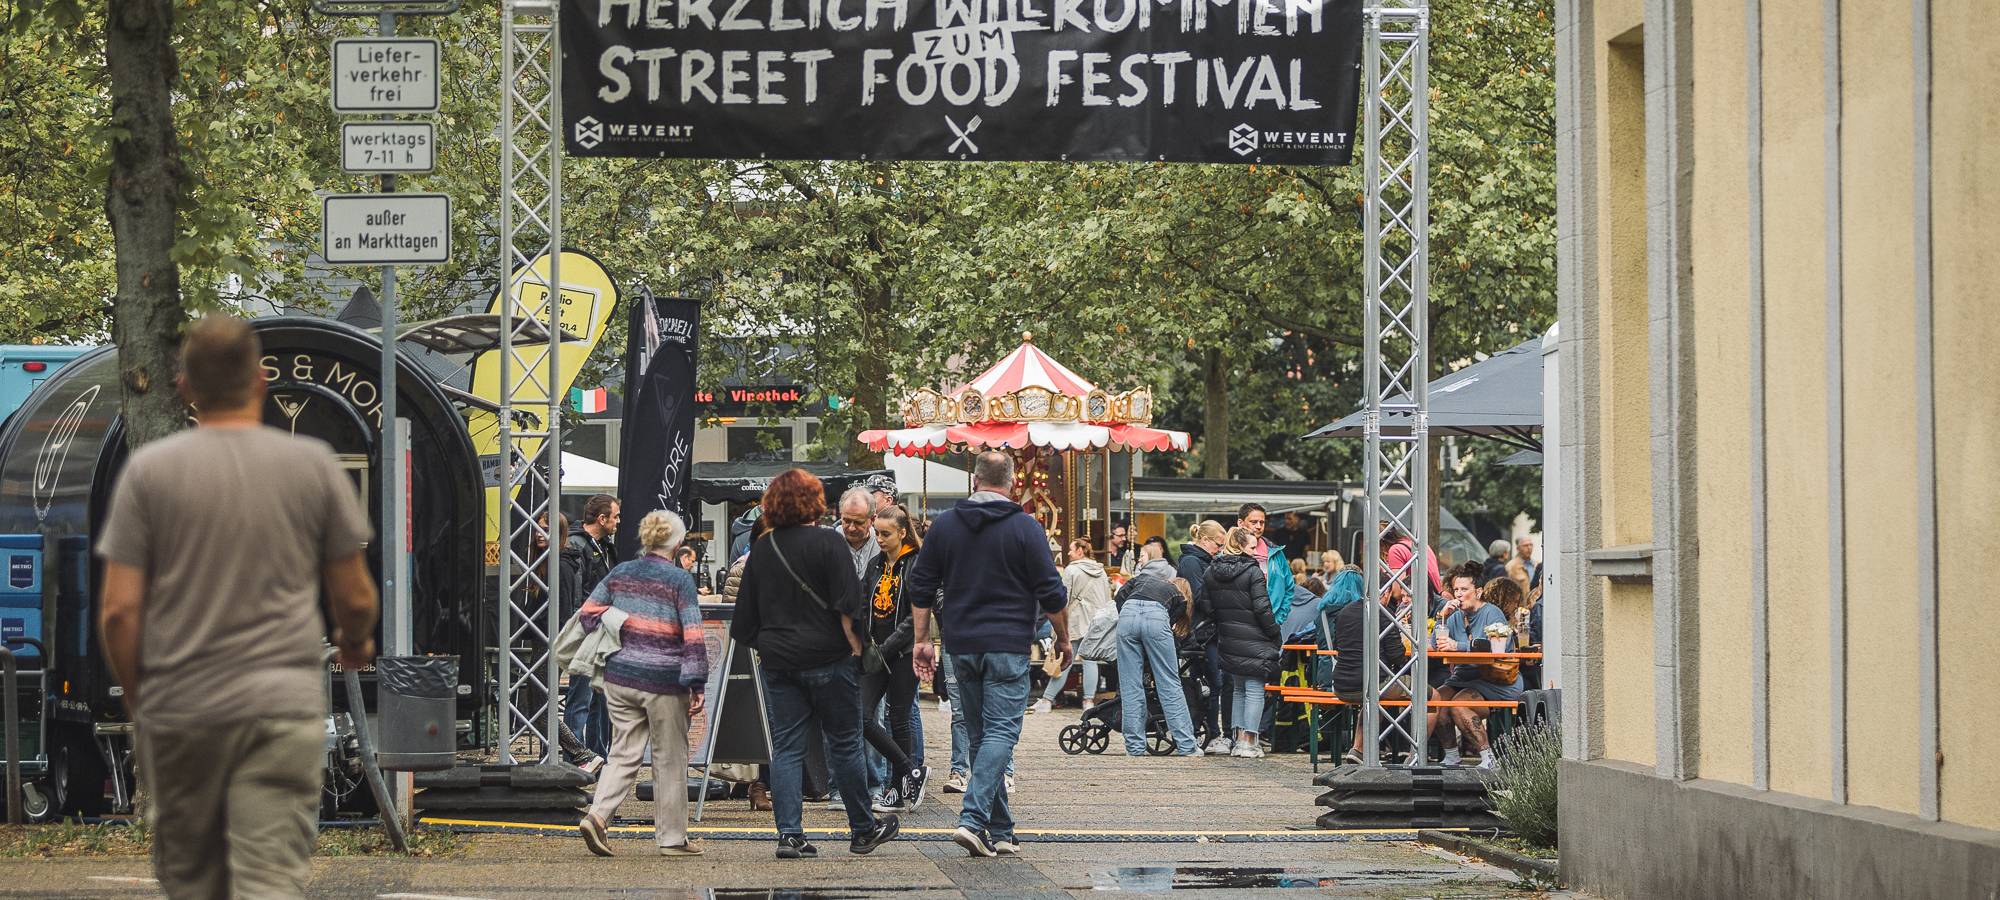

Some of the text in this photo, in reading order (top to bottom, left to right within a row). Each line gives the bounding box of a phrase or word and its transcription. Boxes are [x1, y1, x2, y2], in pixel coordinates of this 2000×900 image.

[597, 0, 909, 31] HERZLICH
[924, 26, 1006, 61] ZUM
[358, 46, 421, 63] Liefer-
[350, 66, 422, 82] verkehr
[598, 45, 1322, 111] STREET FOOD FESTIVAL
[370, 85, 402, 101] frei
[608, 124, 695, 137] WEVENT
[1264, 131, 1347, 144] WEVENT
[350, 132, 426, 149] werktags
[364, 150, 413, 164] 7-11 h
[366, 209, 406, 226] außer
[335, 233, 438, 253] an Markttagen
[292, 354, 314, 381] &
[731, 389, 799, 402] Vinothek
[658, 430, 688, 511] MORE
[741, 481, 769, 491] coffee-b
